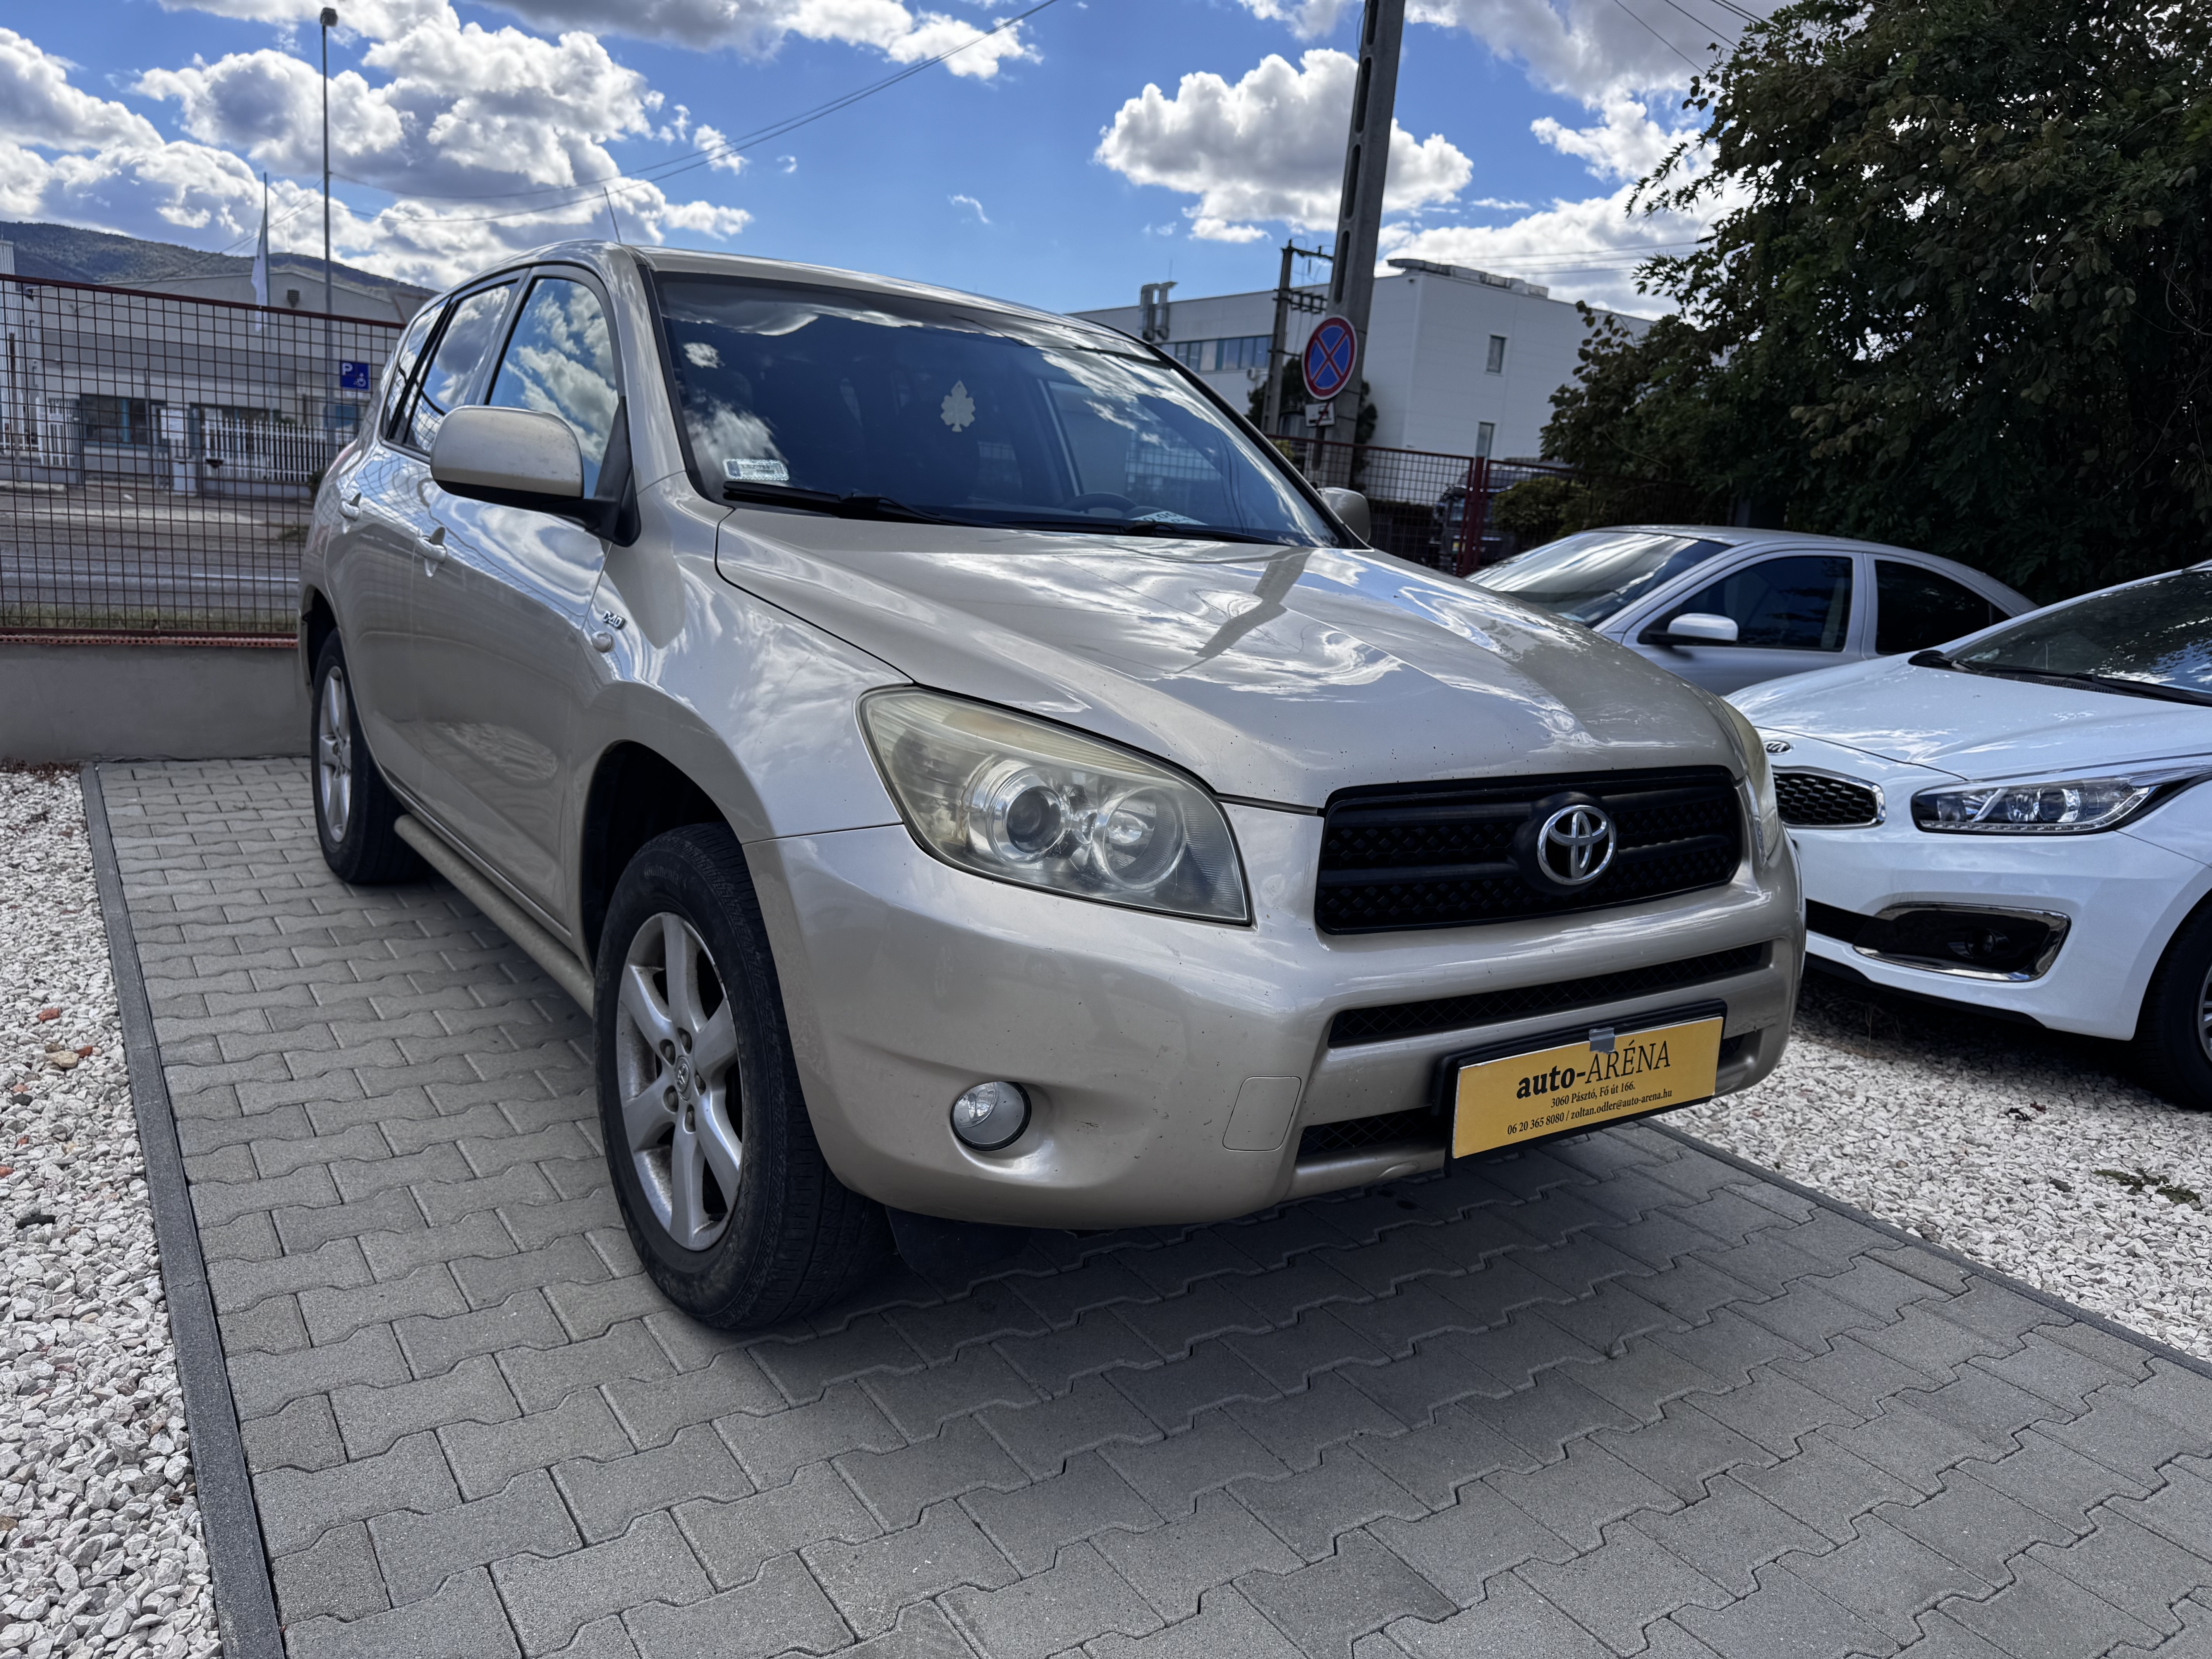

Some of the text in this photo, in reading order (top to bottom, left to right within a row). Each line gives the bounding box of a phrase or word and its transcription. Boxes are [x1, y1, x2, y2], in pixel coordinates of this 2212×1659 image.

[342, 362, 353, 376] P
[603, 610, 623, 627] D-4D
[1516, 1039, 1671, 1099] auto-ARÉNA
[1551, 1081, 1635, 1108] 3060 Pásztó, Fő út 166.
[1508, 1089, 1672, 1135] 06 20 365 8080 / zoltan.odler@auto-arena.hu
